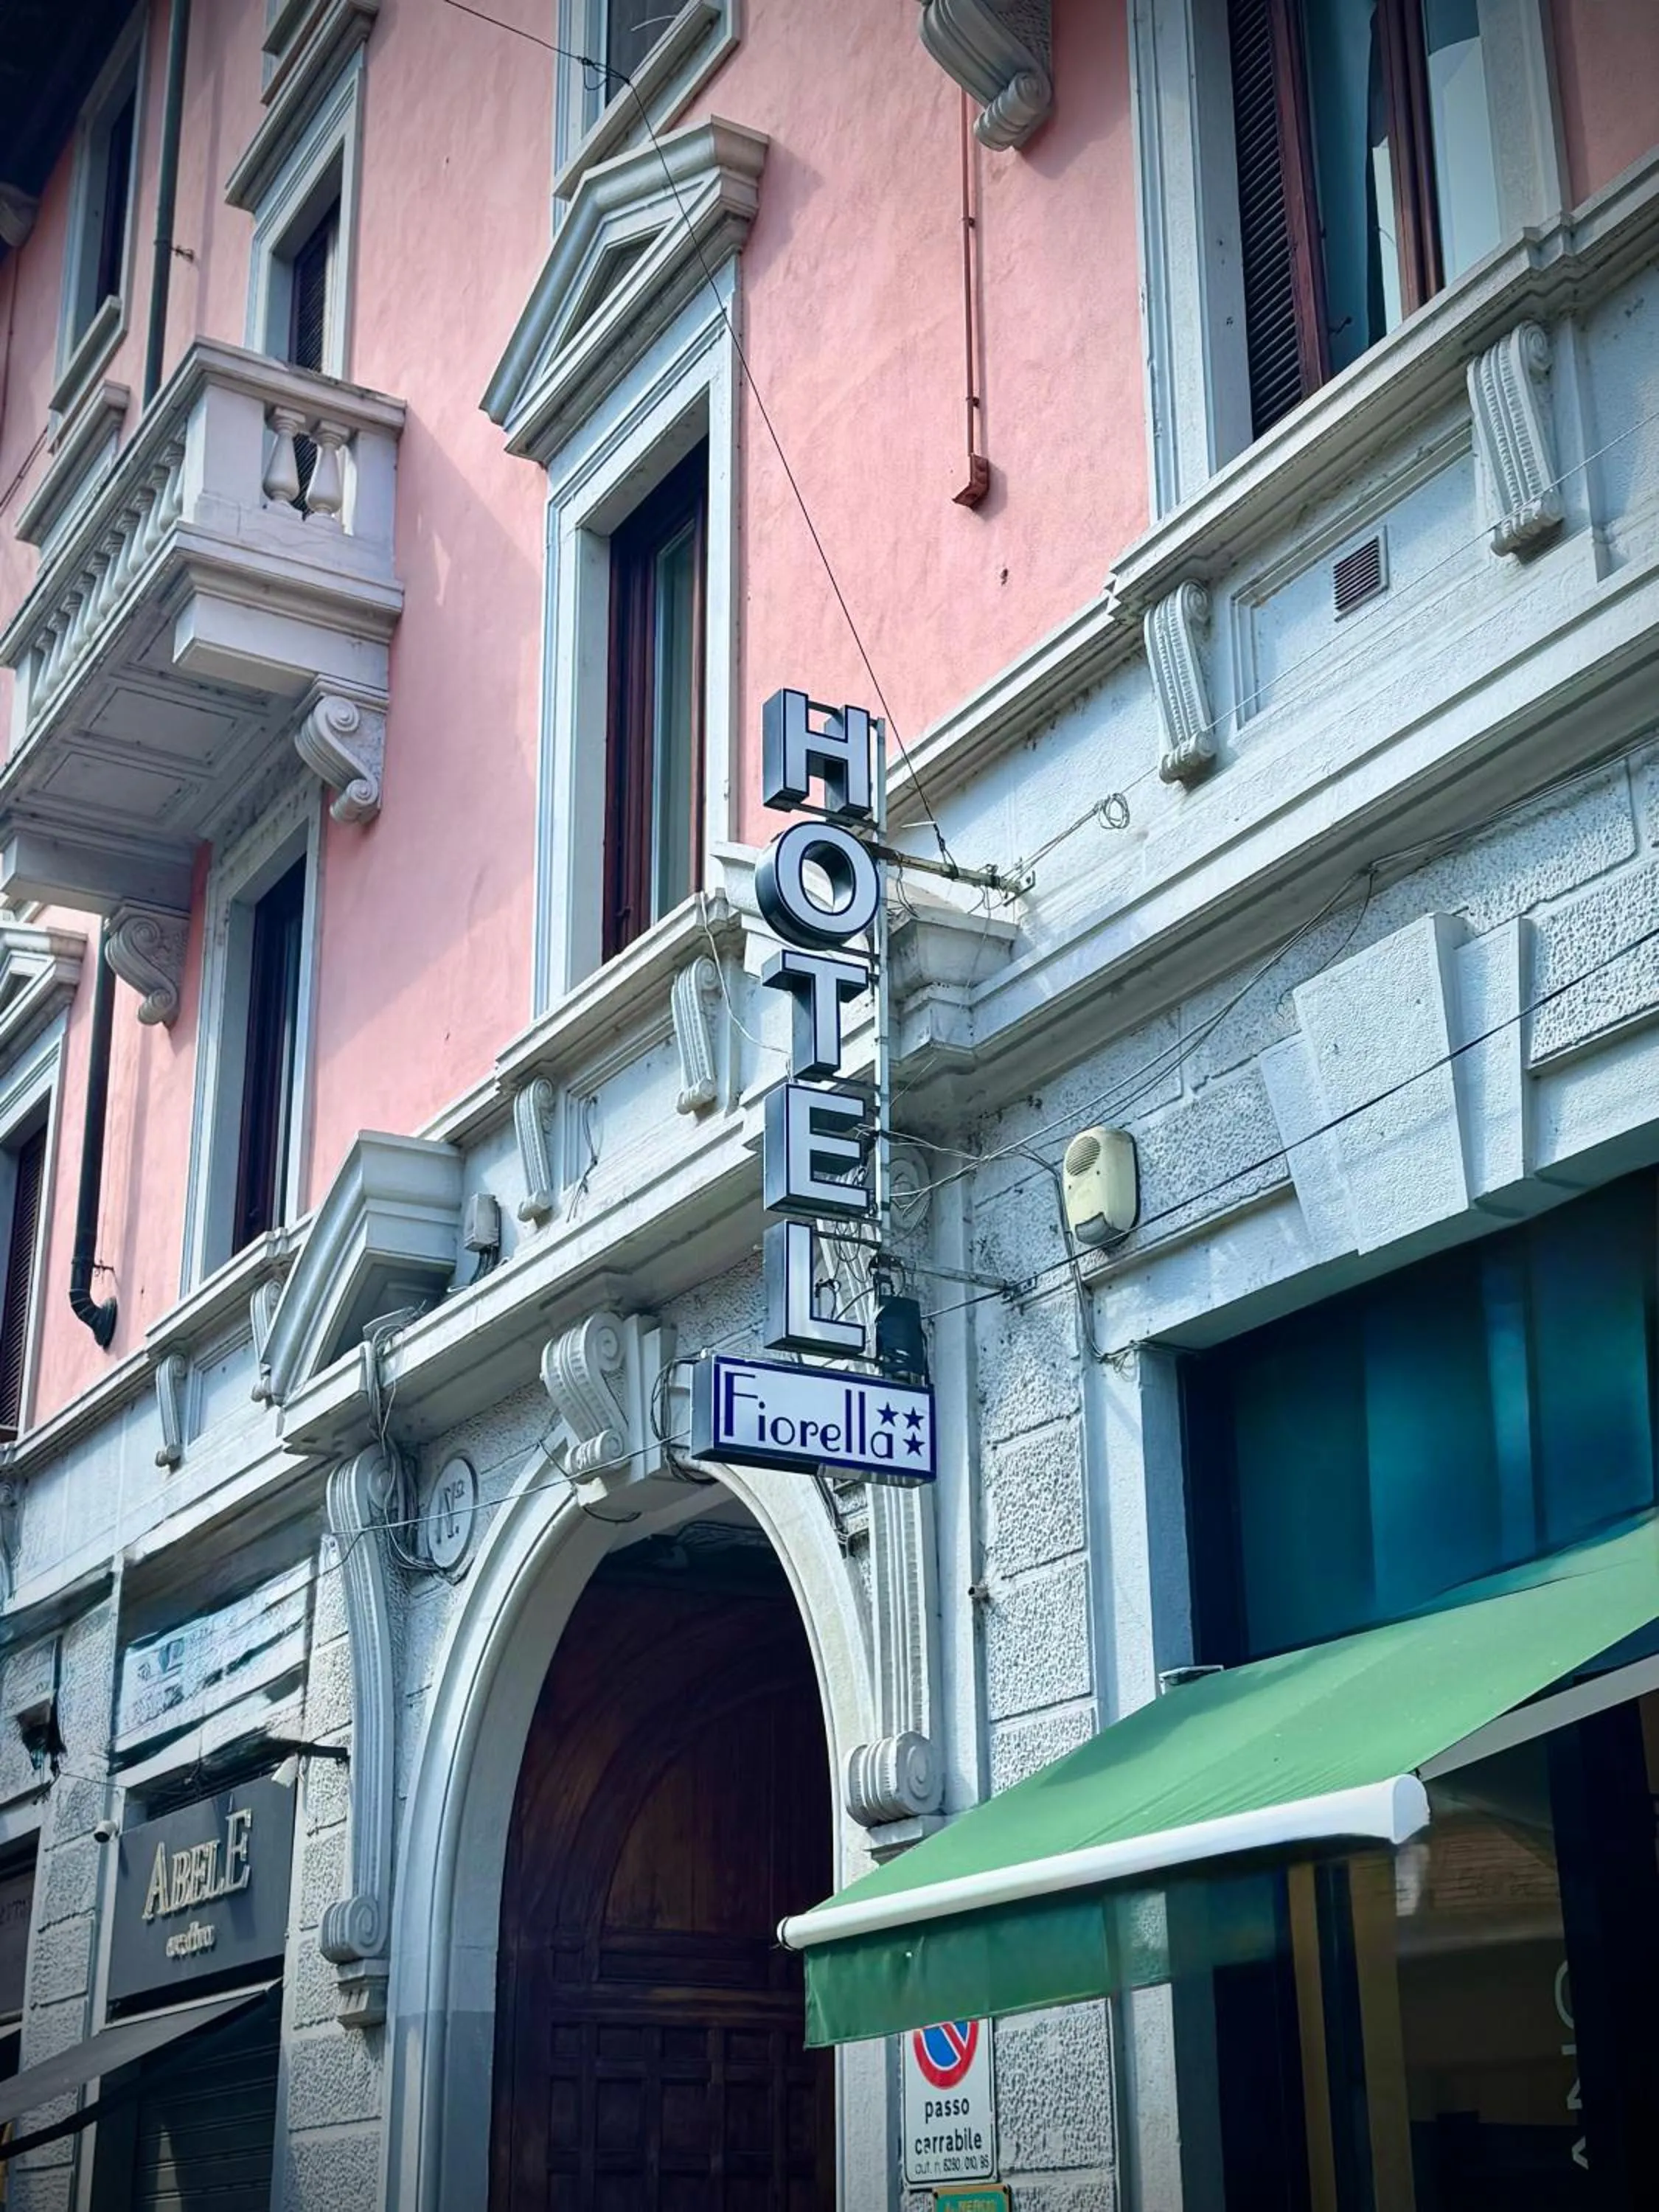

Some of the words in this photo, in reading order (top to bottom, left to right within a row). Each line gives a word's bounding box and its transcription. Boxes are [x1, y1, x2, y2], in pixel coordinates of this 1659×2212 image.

[767, 689, 880, 1354] HOTEL
[723, 1371, 894, 1459] Fiorella
[142, 1808, 251, 1920] ABELE
[915, 2126, 981, 2155] carrabile
[925, 2098, 970, 2124] passo
